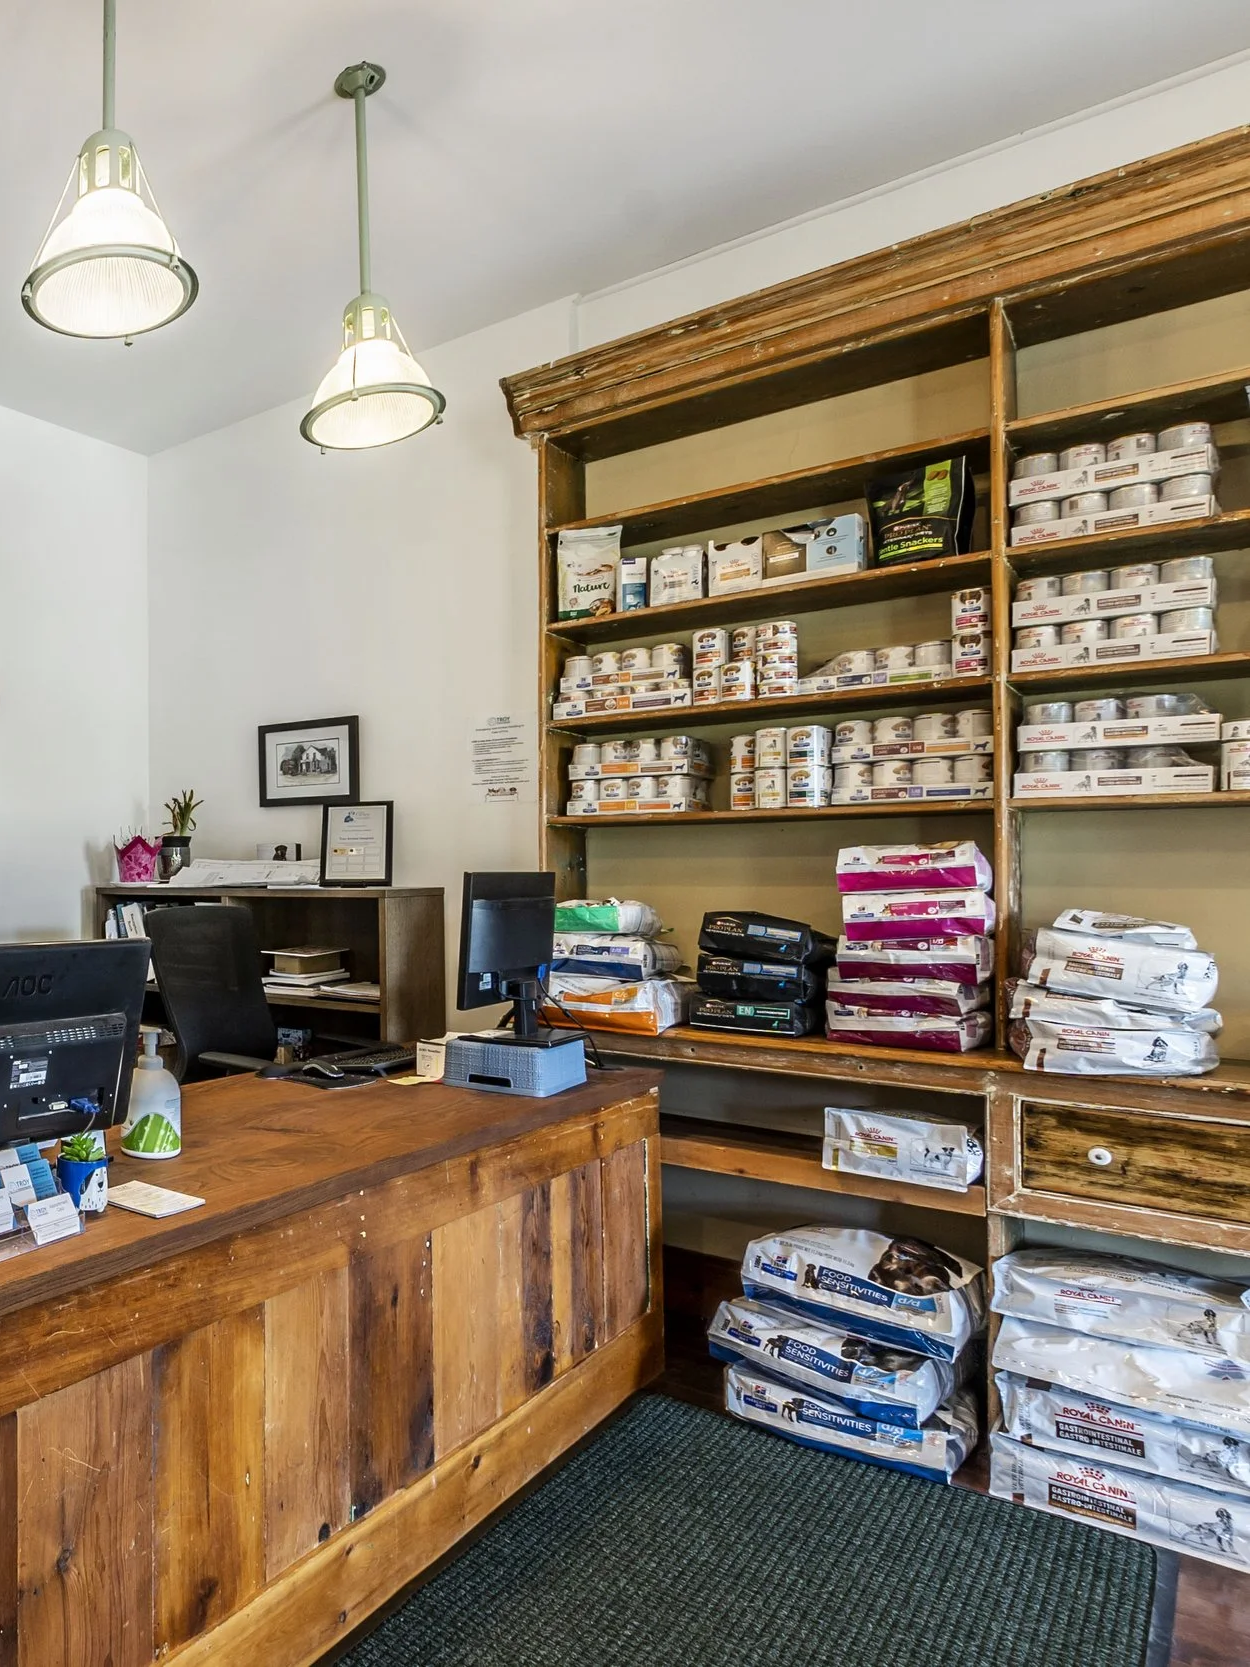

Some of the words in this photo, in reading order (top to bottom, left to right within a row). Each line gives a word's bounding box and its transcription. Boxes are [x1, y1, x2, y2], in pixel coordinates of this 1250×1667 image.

[878, 543, 899, 555] entle
[900, 536, 944, 548] Snackers
[572, 581, 611, 594] Nature
[2, 974, 54, 999] AOC
[15, 1179, 30, 1188] TROY
[822, 1268, 852, 1283] FOOD
[819, 1275, 889, 1302] SENSITIVITIES
[897, 1296, 921, 1308] d/d
[1060, 1288, 1086, 1300] ROYAL
[1087, 1290, 1116, 1303] CANIN
[787, 1339, 817, 1355] FOOD
[784, 1346, 849, 1377] SENSITIVITIES
[801, 1407, 872, 1433] SENSITIVITIES
[1062, 1406, 1097, 1422] ROYAL
[1098, 1415, 1135, 1431] CANIN
[1058, 1423, 1134, 1447] GASTROINTESTINAL
[1056, 1471, 1090, 1488] ROYAL
[1092, 1482, 1129, 1499] CANIN
[1051, 1486, 1126, 1515] GASTROINTESTINAL
